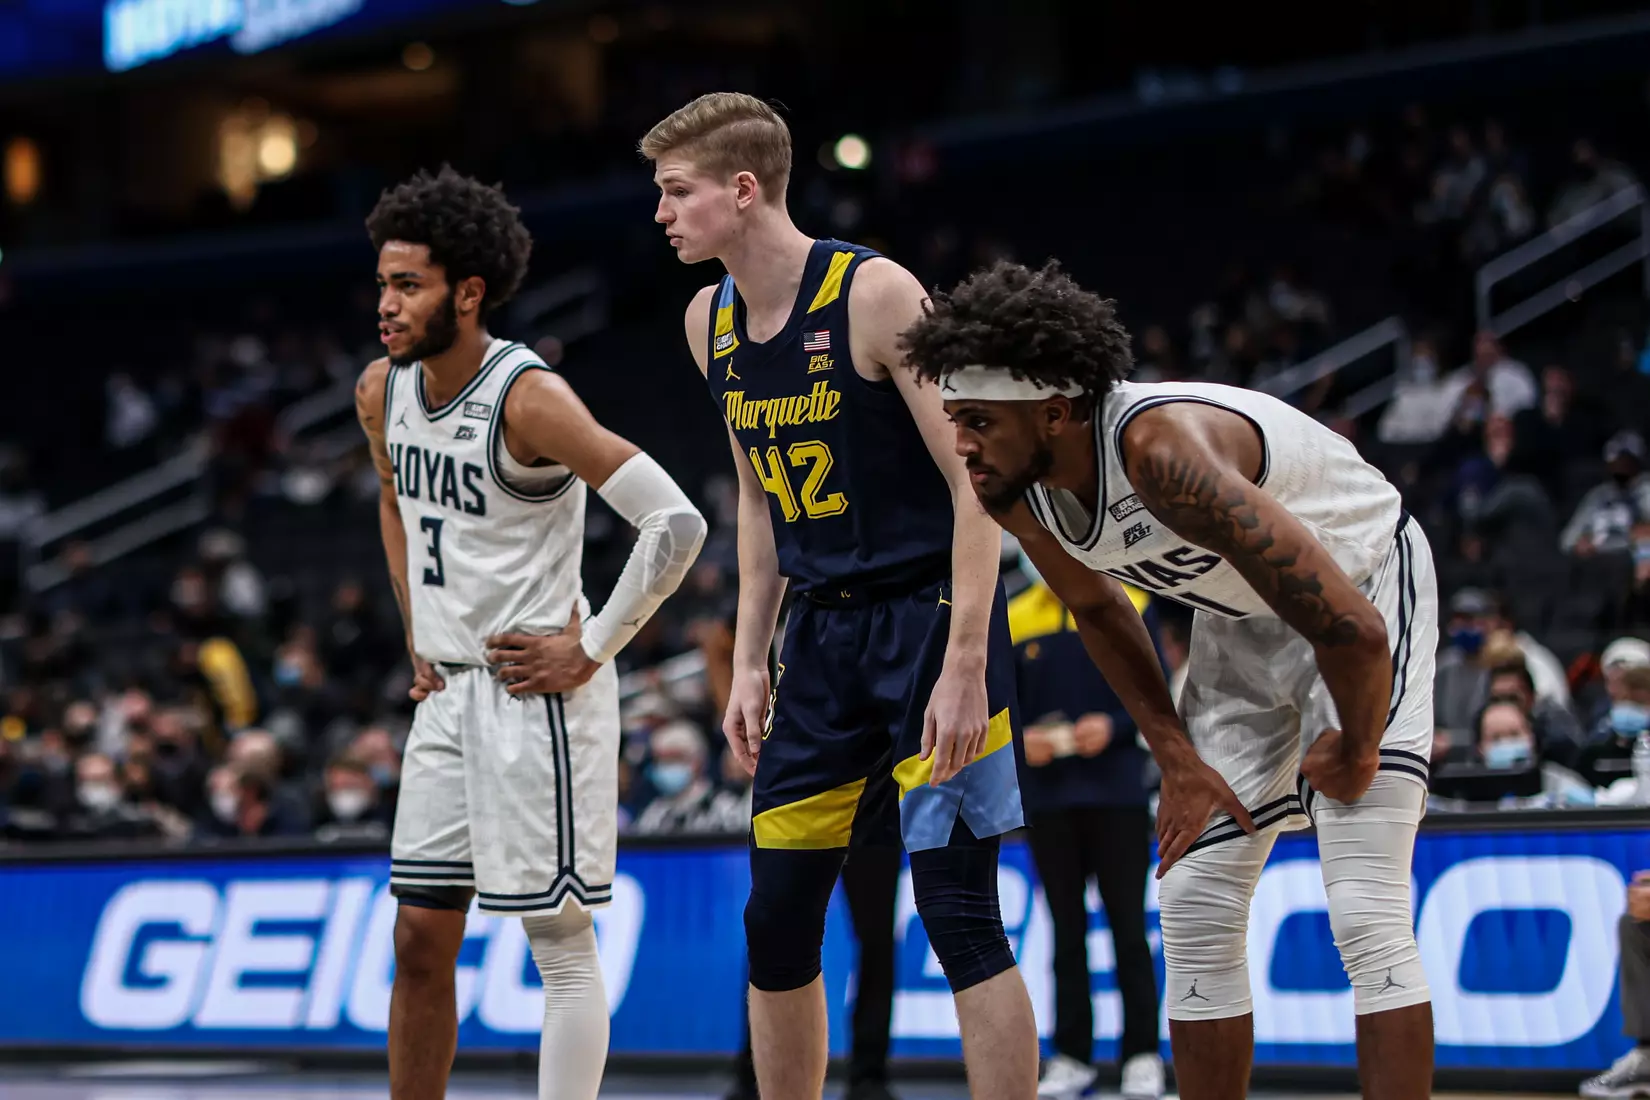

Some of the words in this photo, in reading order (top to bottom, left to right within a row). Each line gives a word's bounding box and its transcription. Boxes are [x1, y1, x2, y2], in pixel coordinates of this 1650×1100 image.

[809, 360, 835, 370] EAST
[810, 354, 829, 363] BIG
[723, 380, 841, 439] Marquette
[750, 440, 849, 522] 42
[1123, 521, 1142, 539] BIG
[1124, 524, 1152, 546] EAST
[420, 516, 445, 587] 3
